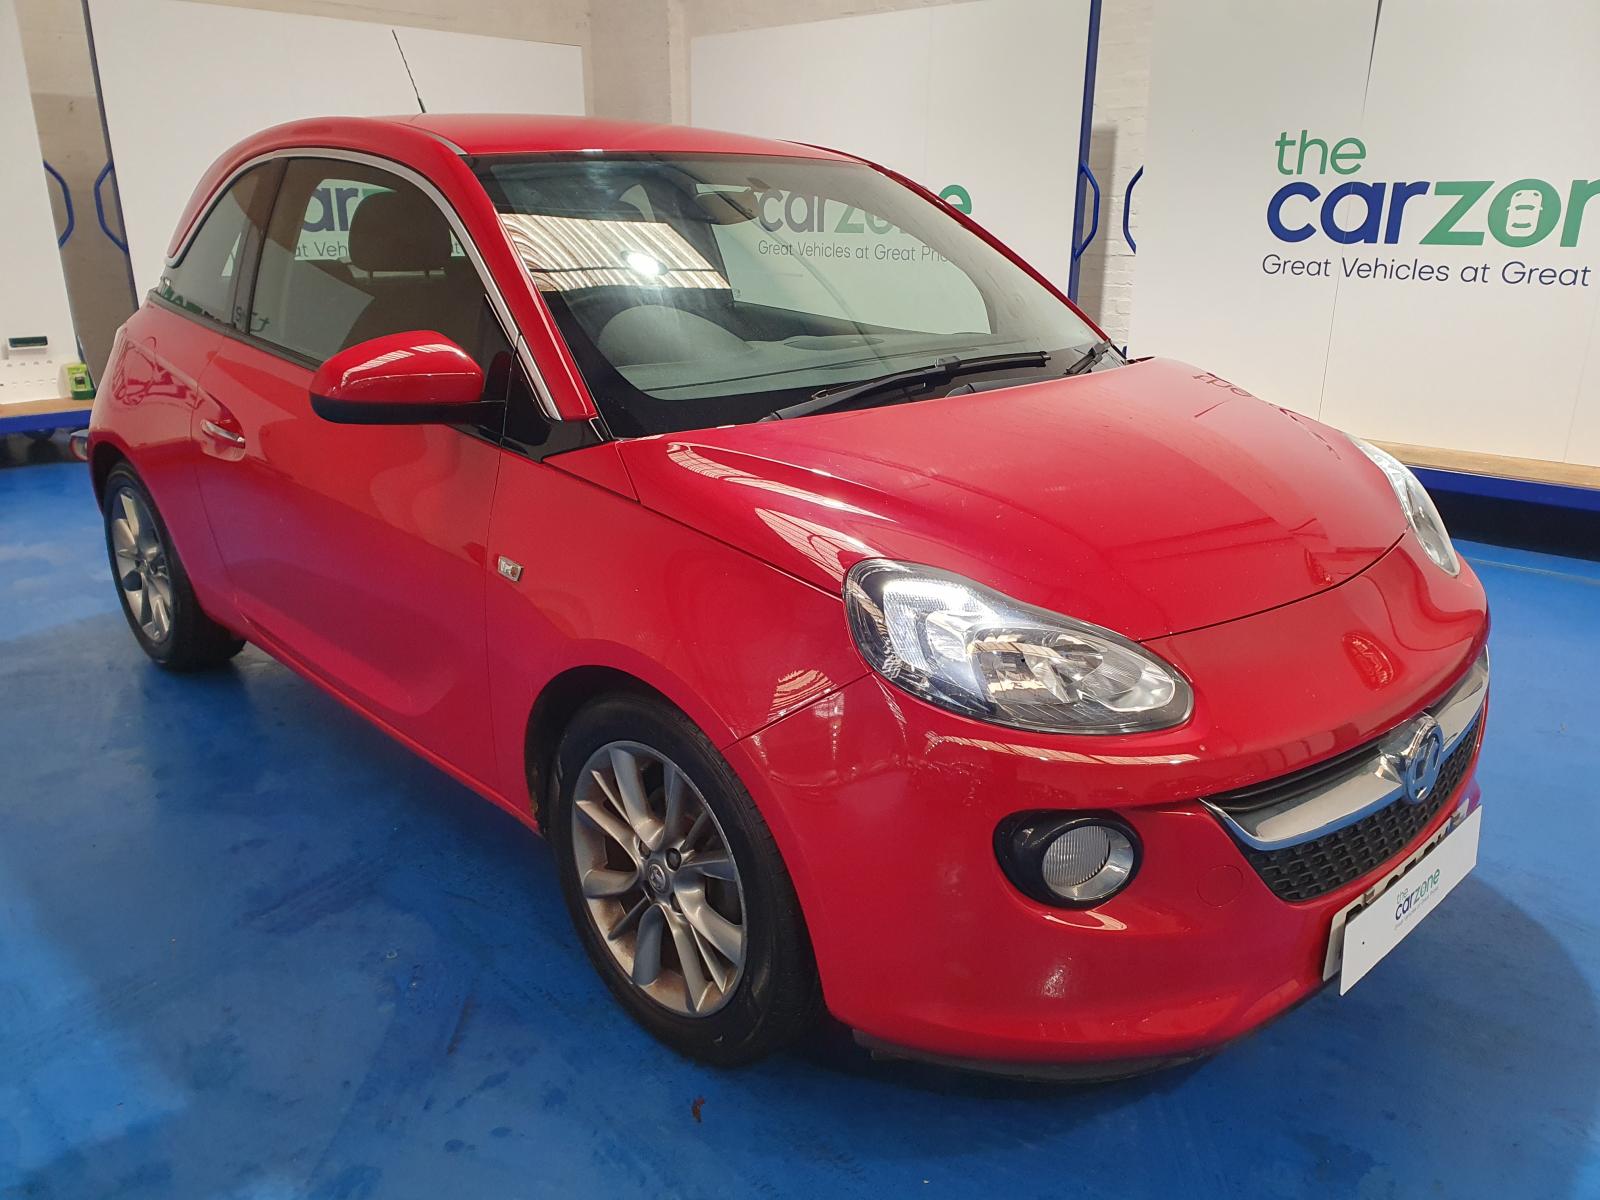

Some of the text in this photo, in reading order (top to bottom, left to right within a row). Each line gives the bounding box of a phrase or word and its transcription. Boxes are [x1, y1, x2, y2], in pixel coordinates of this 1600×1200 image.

[1274, 130, 1367, 175] the
[758, 239, 794, 256] Great
[797, 241, 851, 259] Vehicles
[855, 244, 870, 259] at
[874, 243, 916, 261] Great
[1262, 254, 1592, 287] Great Vehicles at Great
[1395, 868, 1441, 921] carzone
